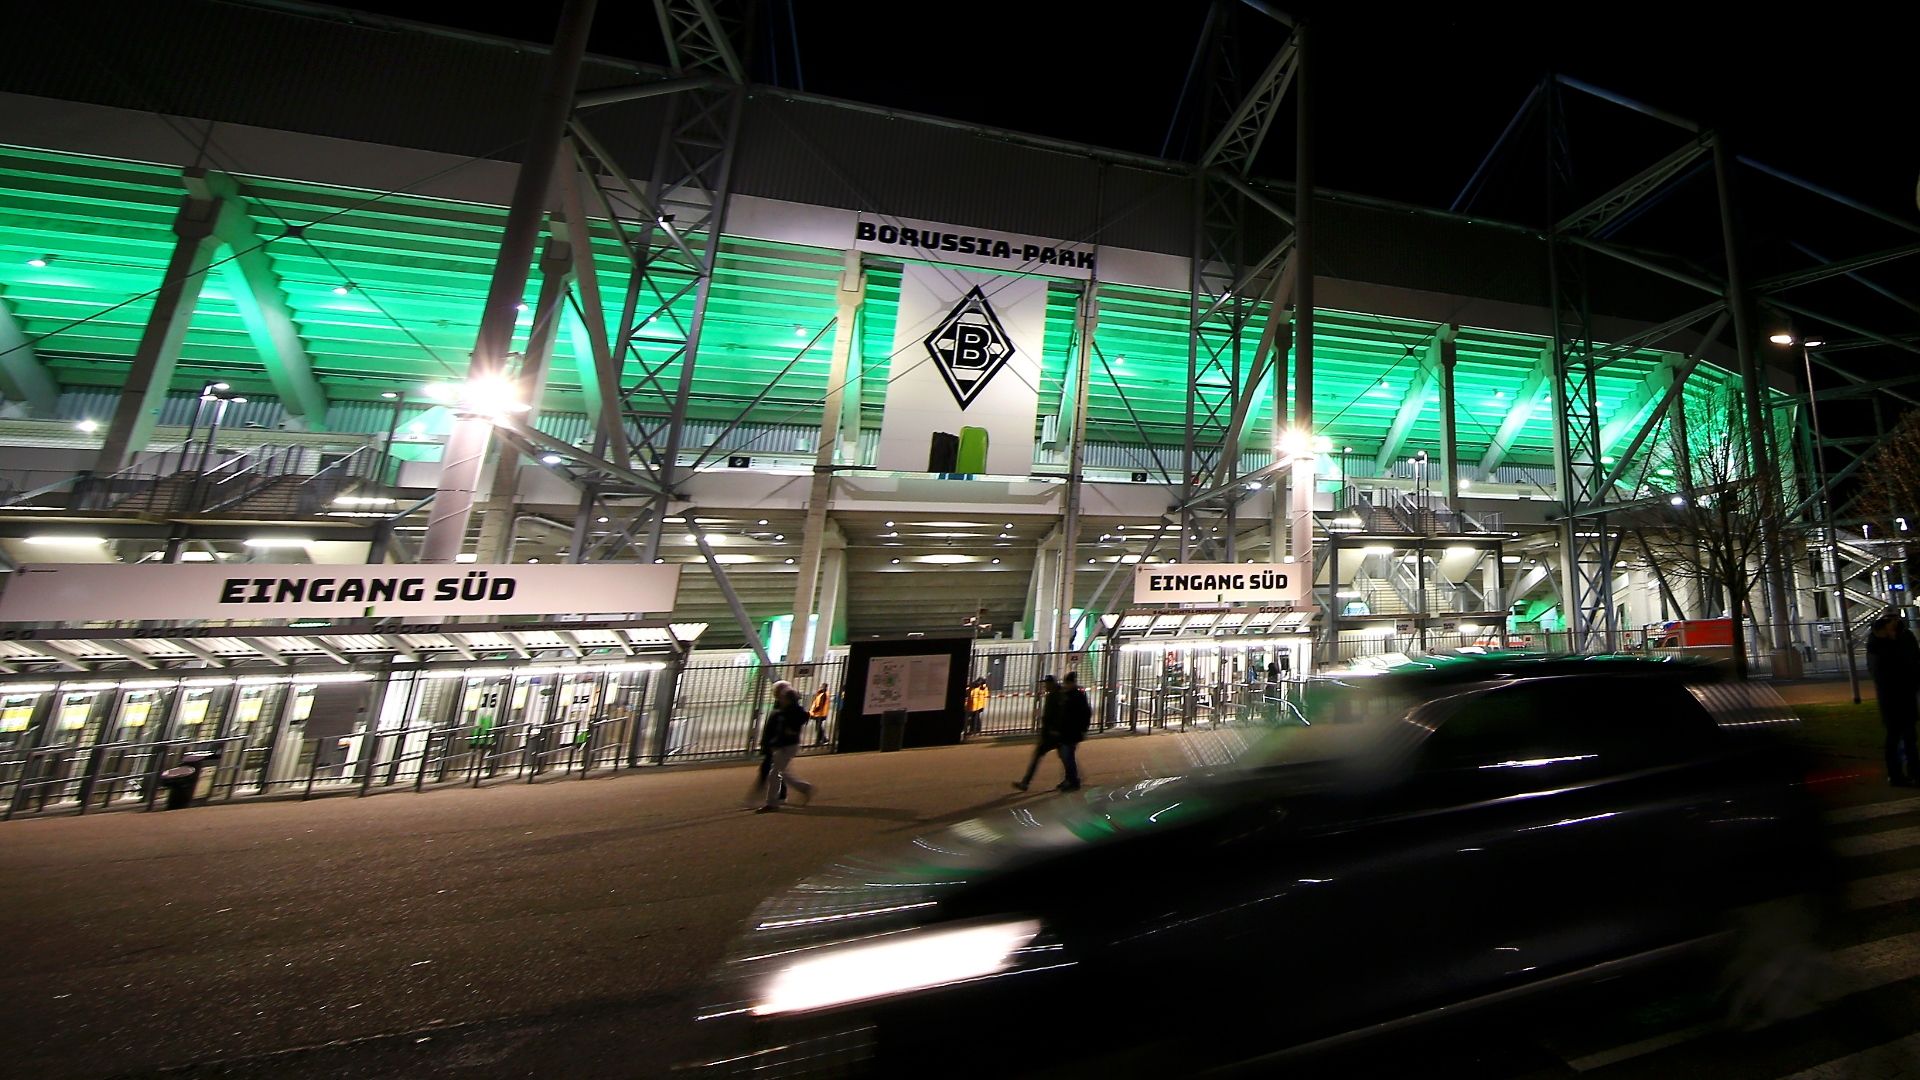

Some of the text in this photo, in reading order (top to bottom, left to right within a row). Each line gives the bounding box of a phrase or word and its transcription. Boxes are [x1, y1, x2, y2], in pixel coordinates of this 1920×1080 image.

[856, 221, 1095, 269] BORUSSIA-PARK
[953, 323, 993, 369] B
[220, 571, 516, 604] EINGANG SÜD
[1150, 569, 1288, 591] EINGANG SÜD
[572, 694, 590, 706] 15
